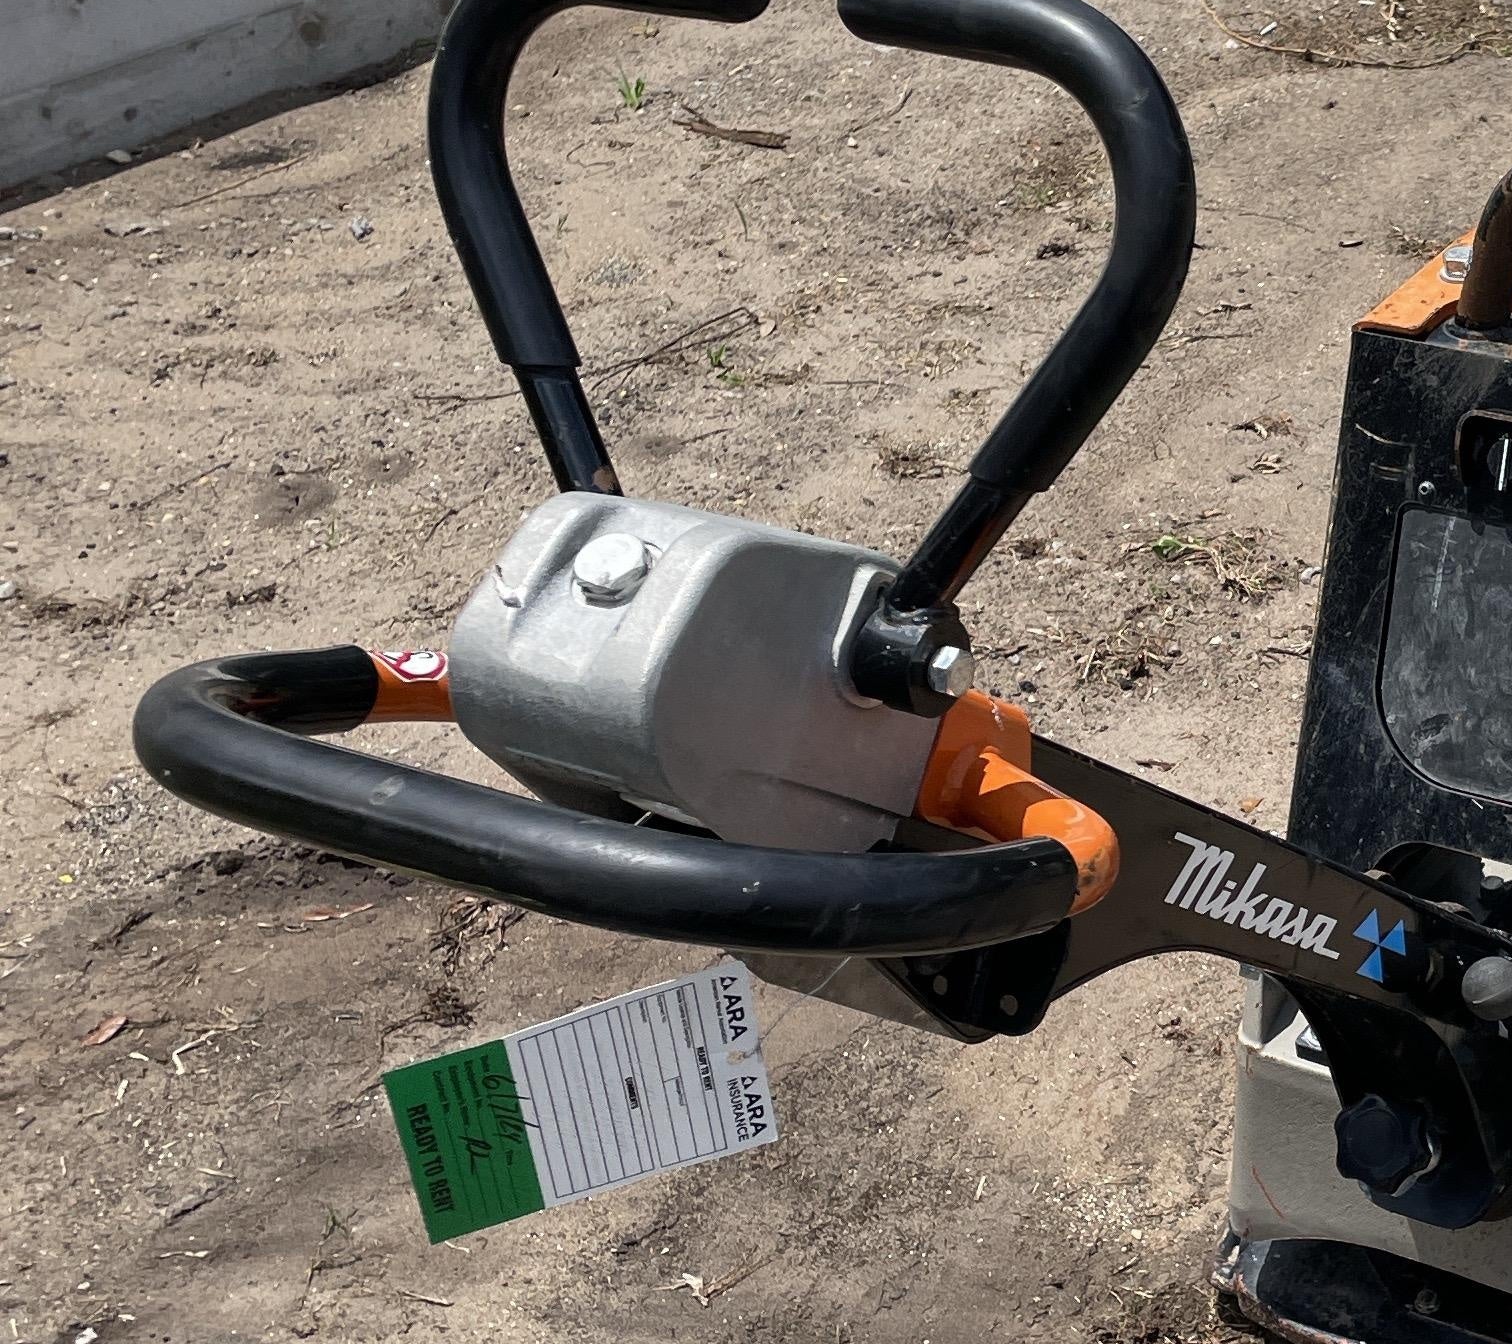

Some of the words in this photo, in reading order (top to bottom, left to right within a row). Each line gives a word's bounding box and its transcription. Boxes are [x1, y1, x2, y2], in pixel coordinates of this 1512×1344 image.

[1163, 831, 1341, 960] Mikasa
[723, 995, 748, 1042] ARA
[697, 1046, 707, 1066] READY
[701, 1066, 709, 1076] TO
[703, 1075, 713, 1092] RENT
[726, 1077, 750, 1143] INSURANCE
[744, 1094, 767, 1137] ARA
[406, 1103, 439, 1157] READY
[421, 1155, 445, 1178] TO
[429, 1178, 455, 1214] RENT
